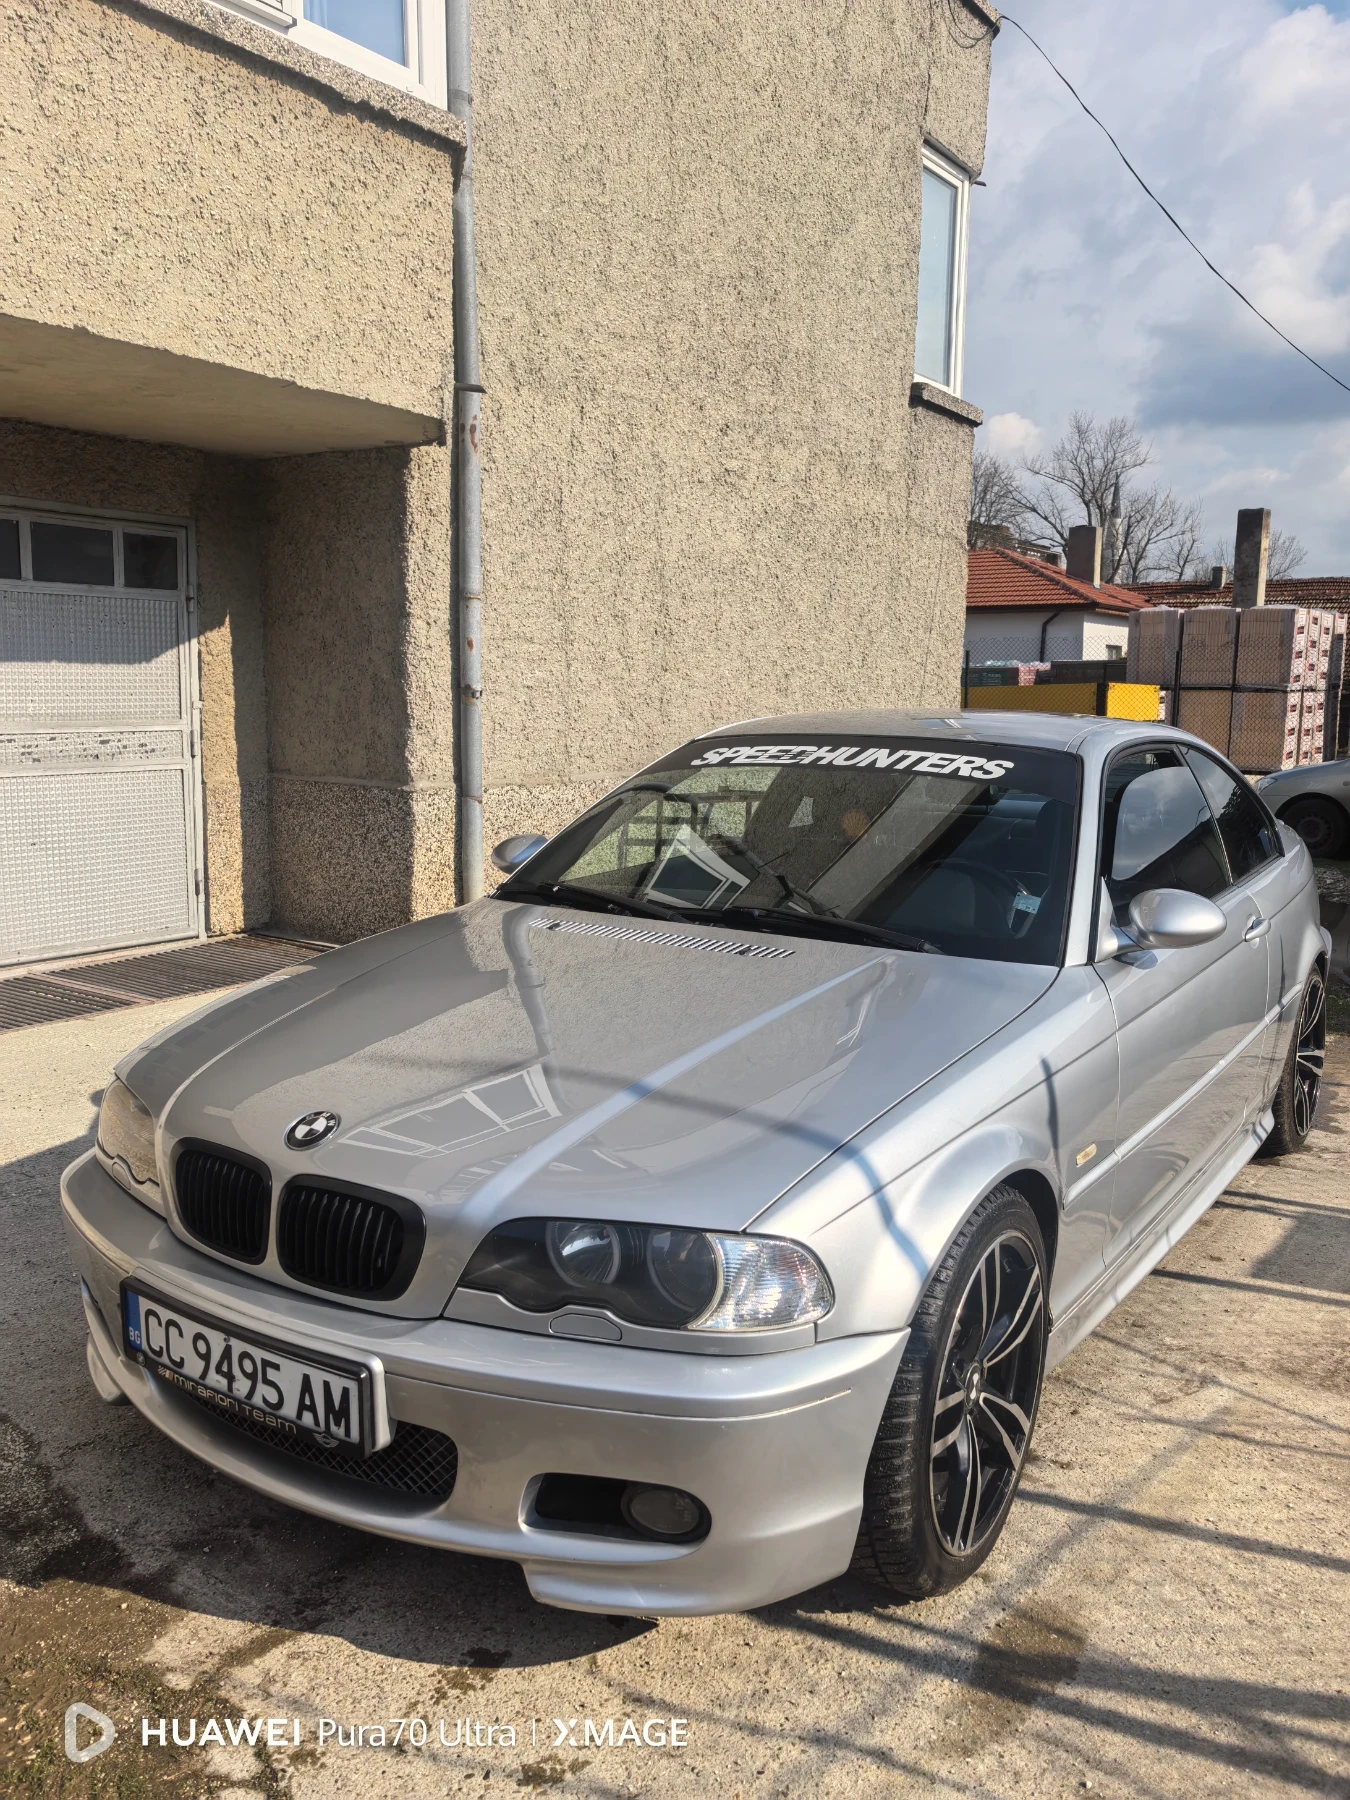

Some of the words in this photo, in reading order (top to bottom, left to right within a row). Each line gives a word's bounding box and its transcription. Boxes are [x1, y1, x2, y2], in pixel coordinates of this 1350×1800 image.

[691, 745, 1014, 779] SPEEDHUNTERS
[129, 1326, 141, 1344] BG
[145, 1308, 184, 1369] CC
[192, 1332, 285, 1411] 9495
[296, 1373, 350, 1438] AM
